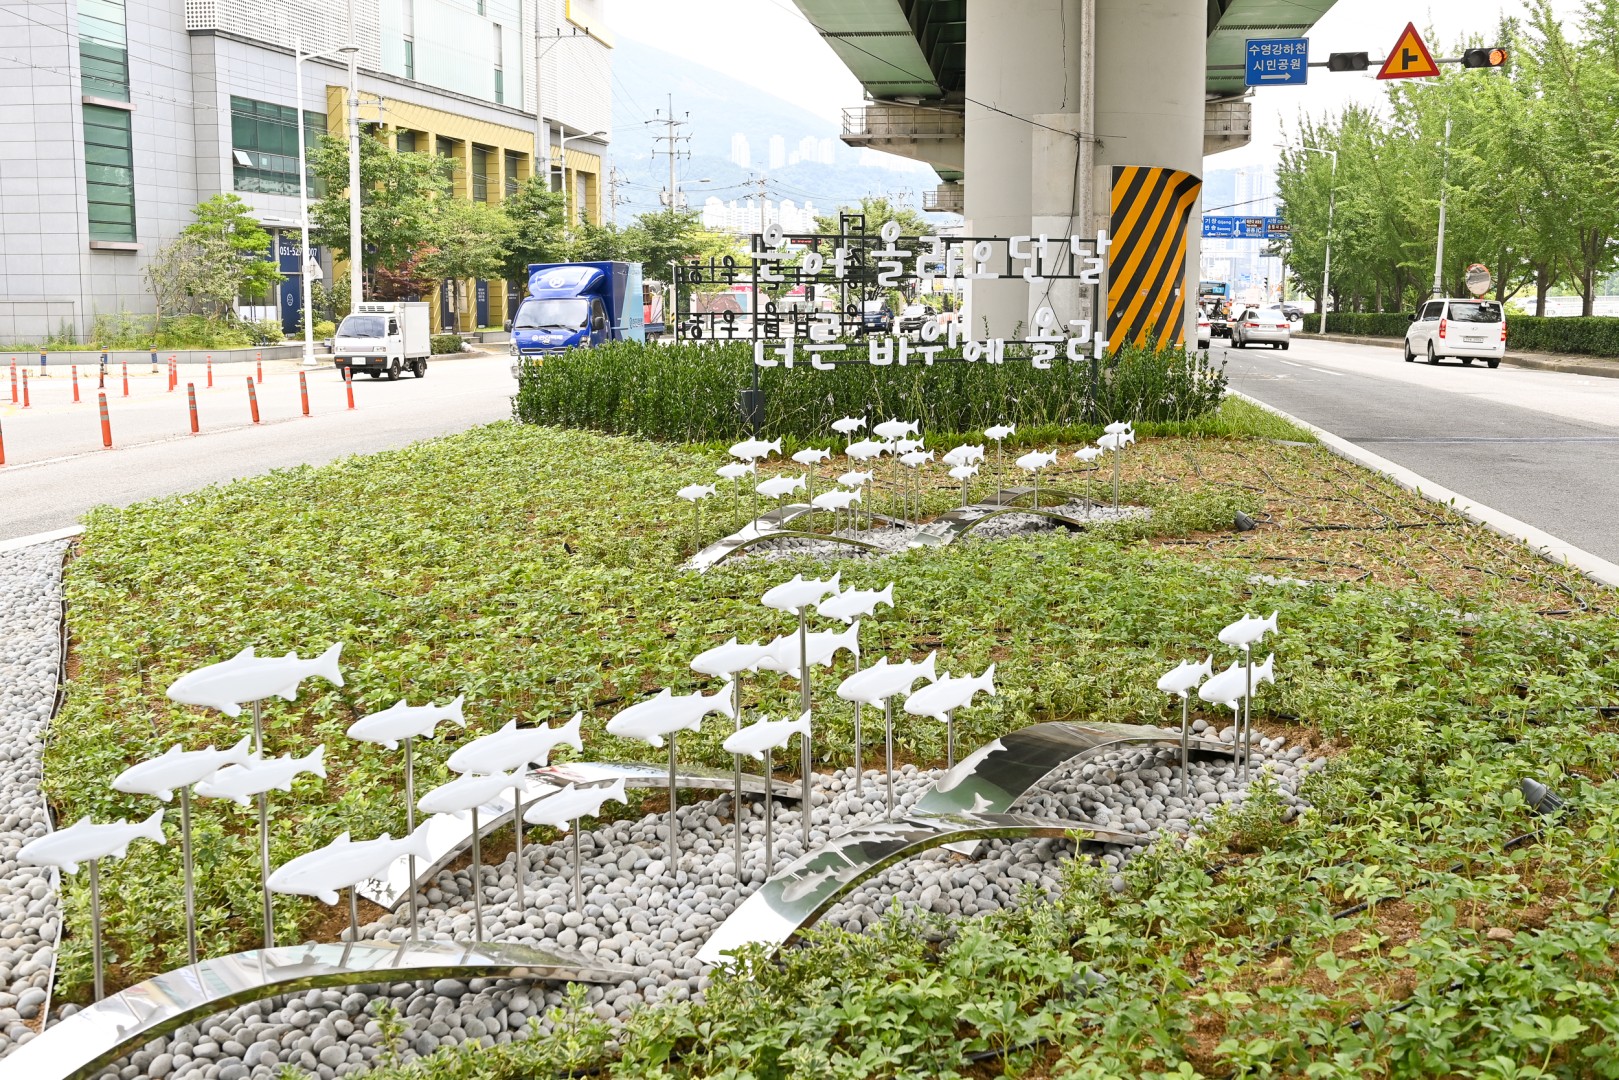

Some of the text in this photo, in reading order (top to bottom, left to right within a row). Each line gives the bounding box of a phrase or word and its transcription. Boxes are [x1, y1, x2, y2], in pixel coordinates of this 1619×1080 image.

[1249, 43, 1306, 56] 수영강하천
[1253, 58, 1301, 71] 시민공원
[751, 223, 850, 282] 은어
[870, 221, 1048, 287] 올라오던
[1070, 230, 1113, 285] 날
[754, 313, 847, 370] 너른
[869, 320, 1004, 366] 바위에
[1026, 306, 1110, 370] 올라
